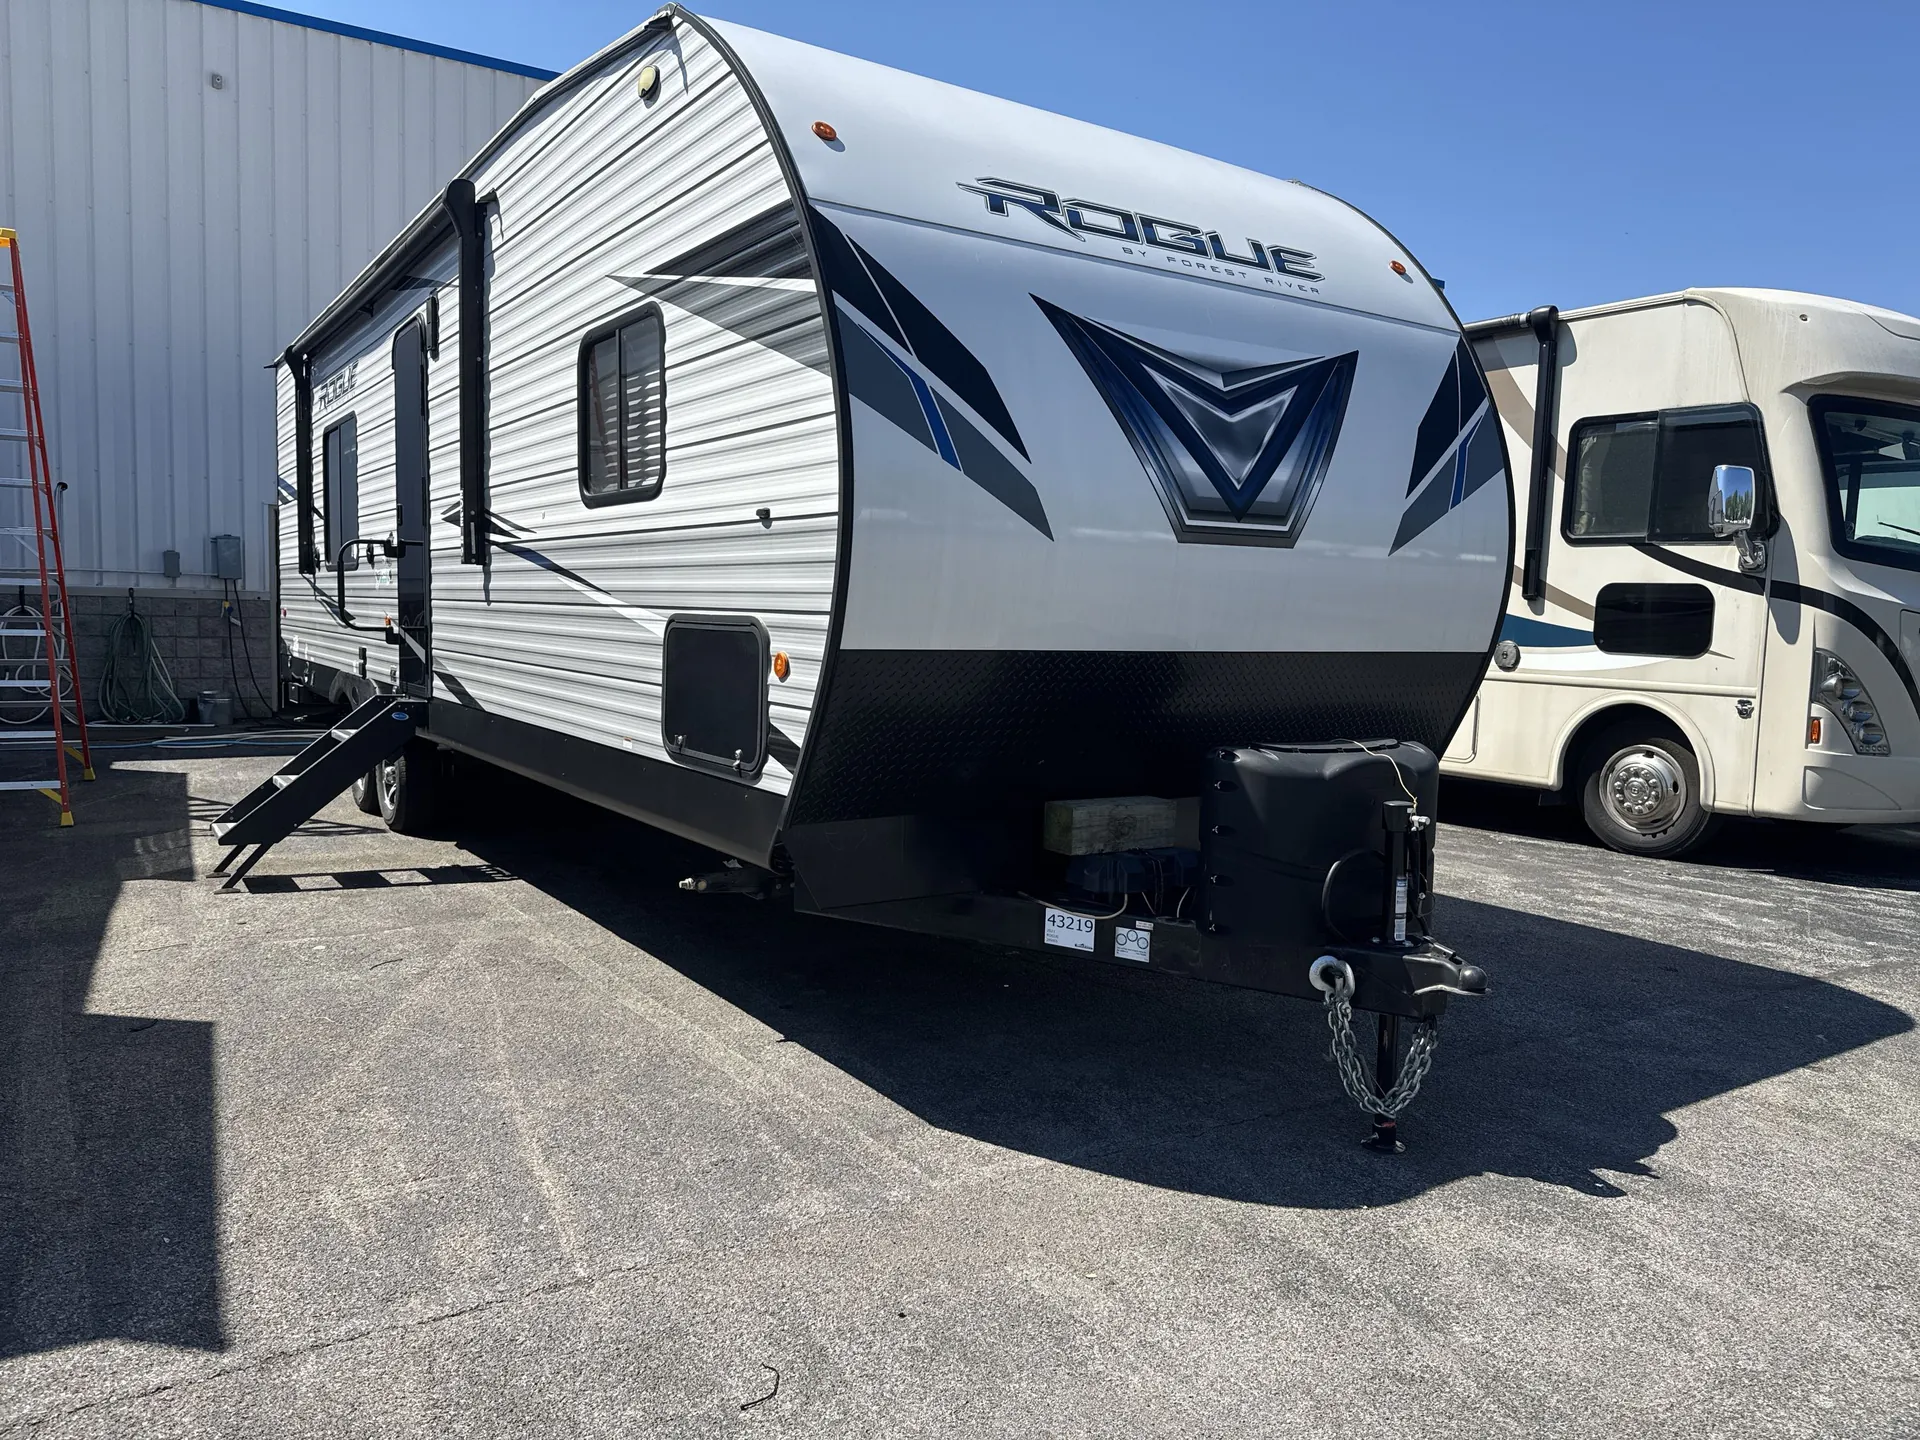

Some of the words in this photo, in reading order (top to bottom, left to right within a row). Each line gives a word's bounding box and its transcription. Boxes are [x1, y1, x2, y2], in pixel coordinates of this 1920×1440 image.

[956, 177, 1325, 283] ROGUE
[1122, 246, 1148, 258] BY
[1166, 255, 1248, 280] FOREST
[1263, 276, 1321, 295] RIVER
[318, 360, 359, 411] ROGUE
[1047, 914, 1094, 933] 43219
